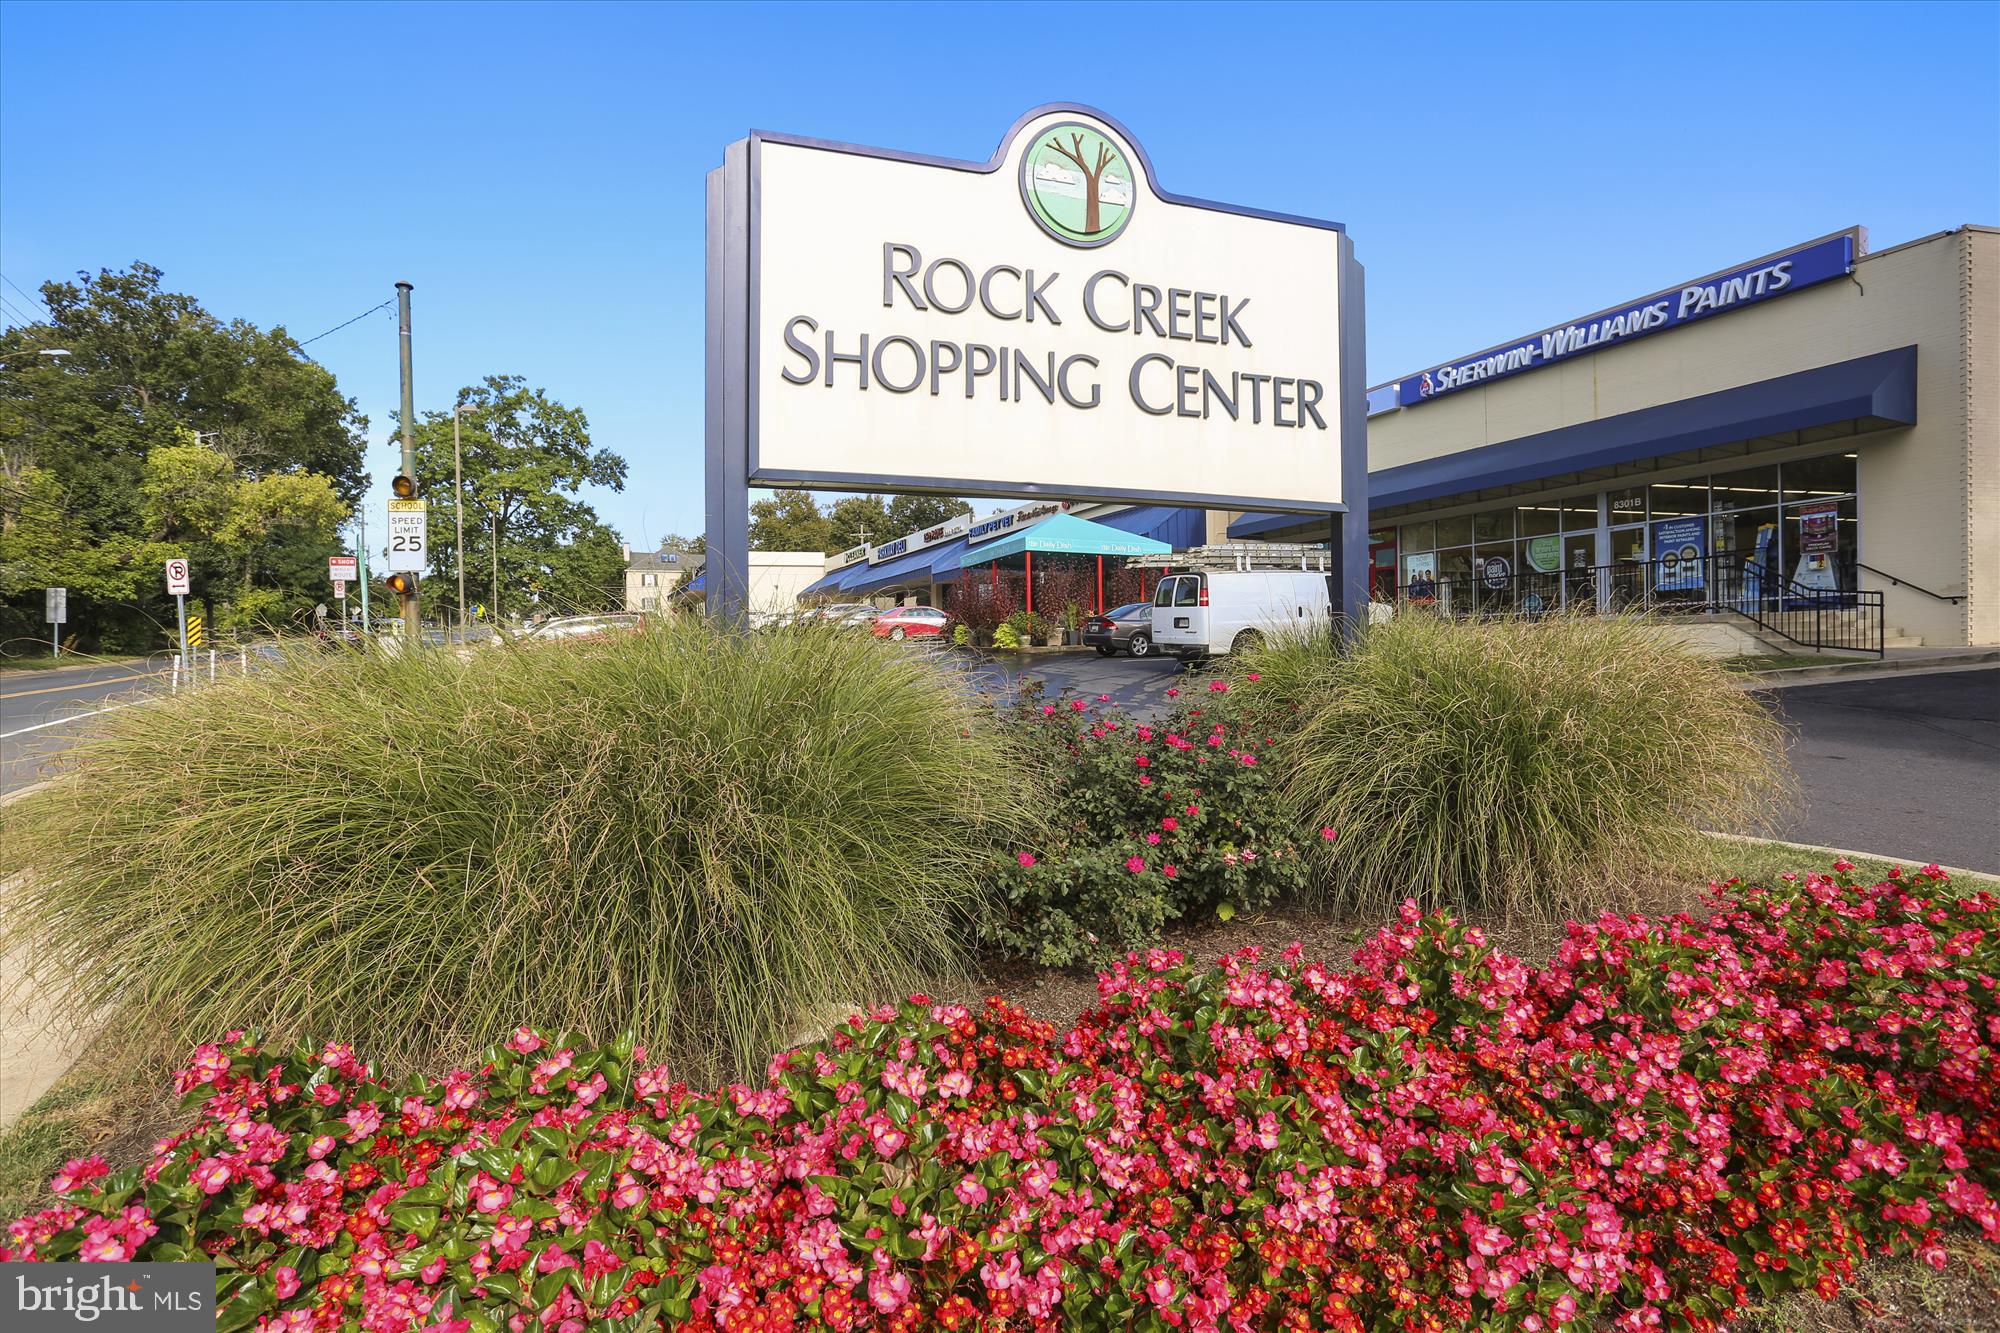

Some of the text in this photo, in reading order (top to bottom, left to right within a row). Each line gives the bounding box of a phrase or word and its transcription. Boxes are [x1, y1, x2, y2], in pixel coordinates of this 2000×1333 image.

[883, 242, 1252, 348] ROCK CREEK
[1436, 261, 1793, 393] SHERWIN-WILLIAMS PAINTS
[781, 315, 1328, 430] SHOPPING CENTER
[390, 502, 423, 510] SCHOOL
[1614, 498, 1641, 509] 8301B
[391, 517, 423, 525] SPEED
[394, 526, 419, 534] LIMIT
[969, 524, 988, 538] FAMILY
[392, 535, 422, 552] 25
[1040, 540, 1056, 549] Daily
[1057, 541, 1072, 549] Dish
[1111, 544, 1127, 553] Daily
[1127, 545, 1142, 553] Dish
